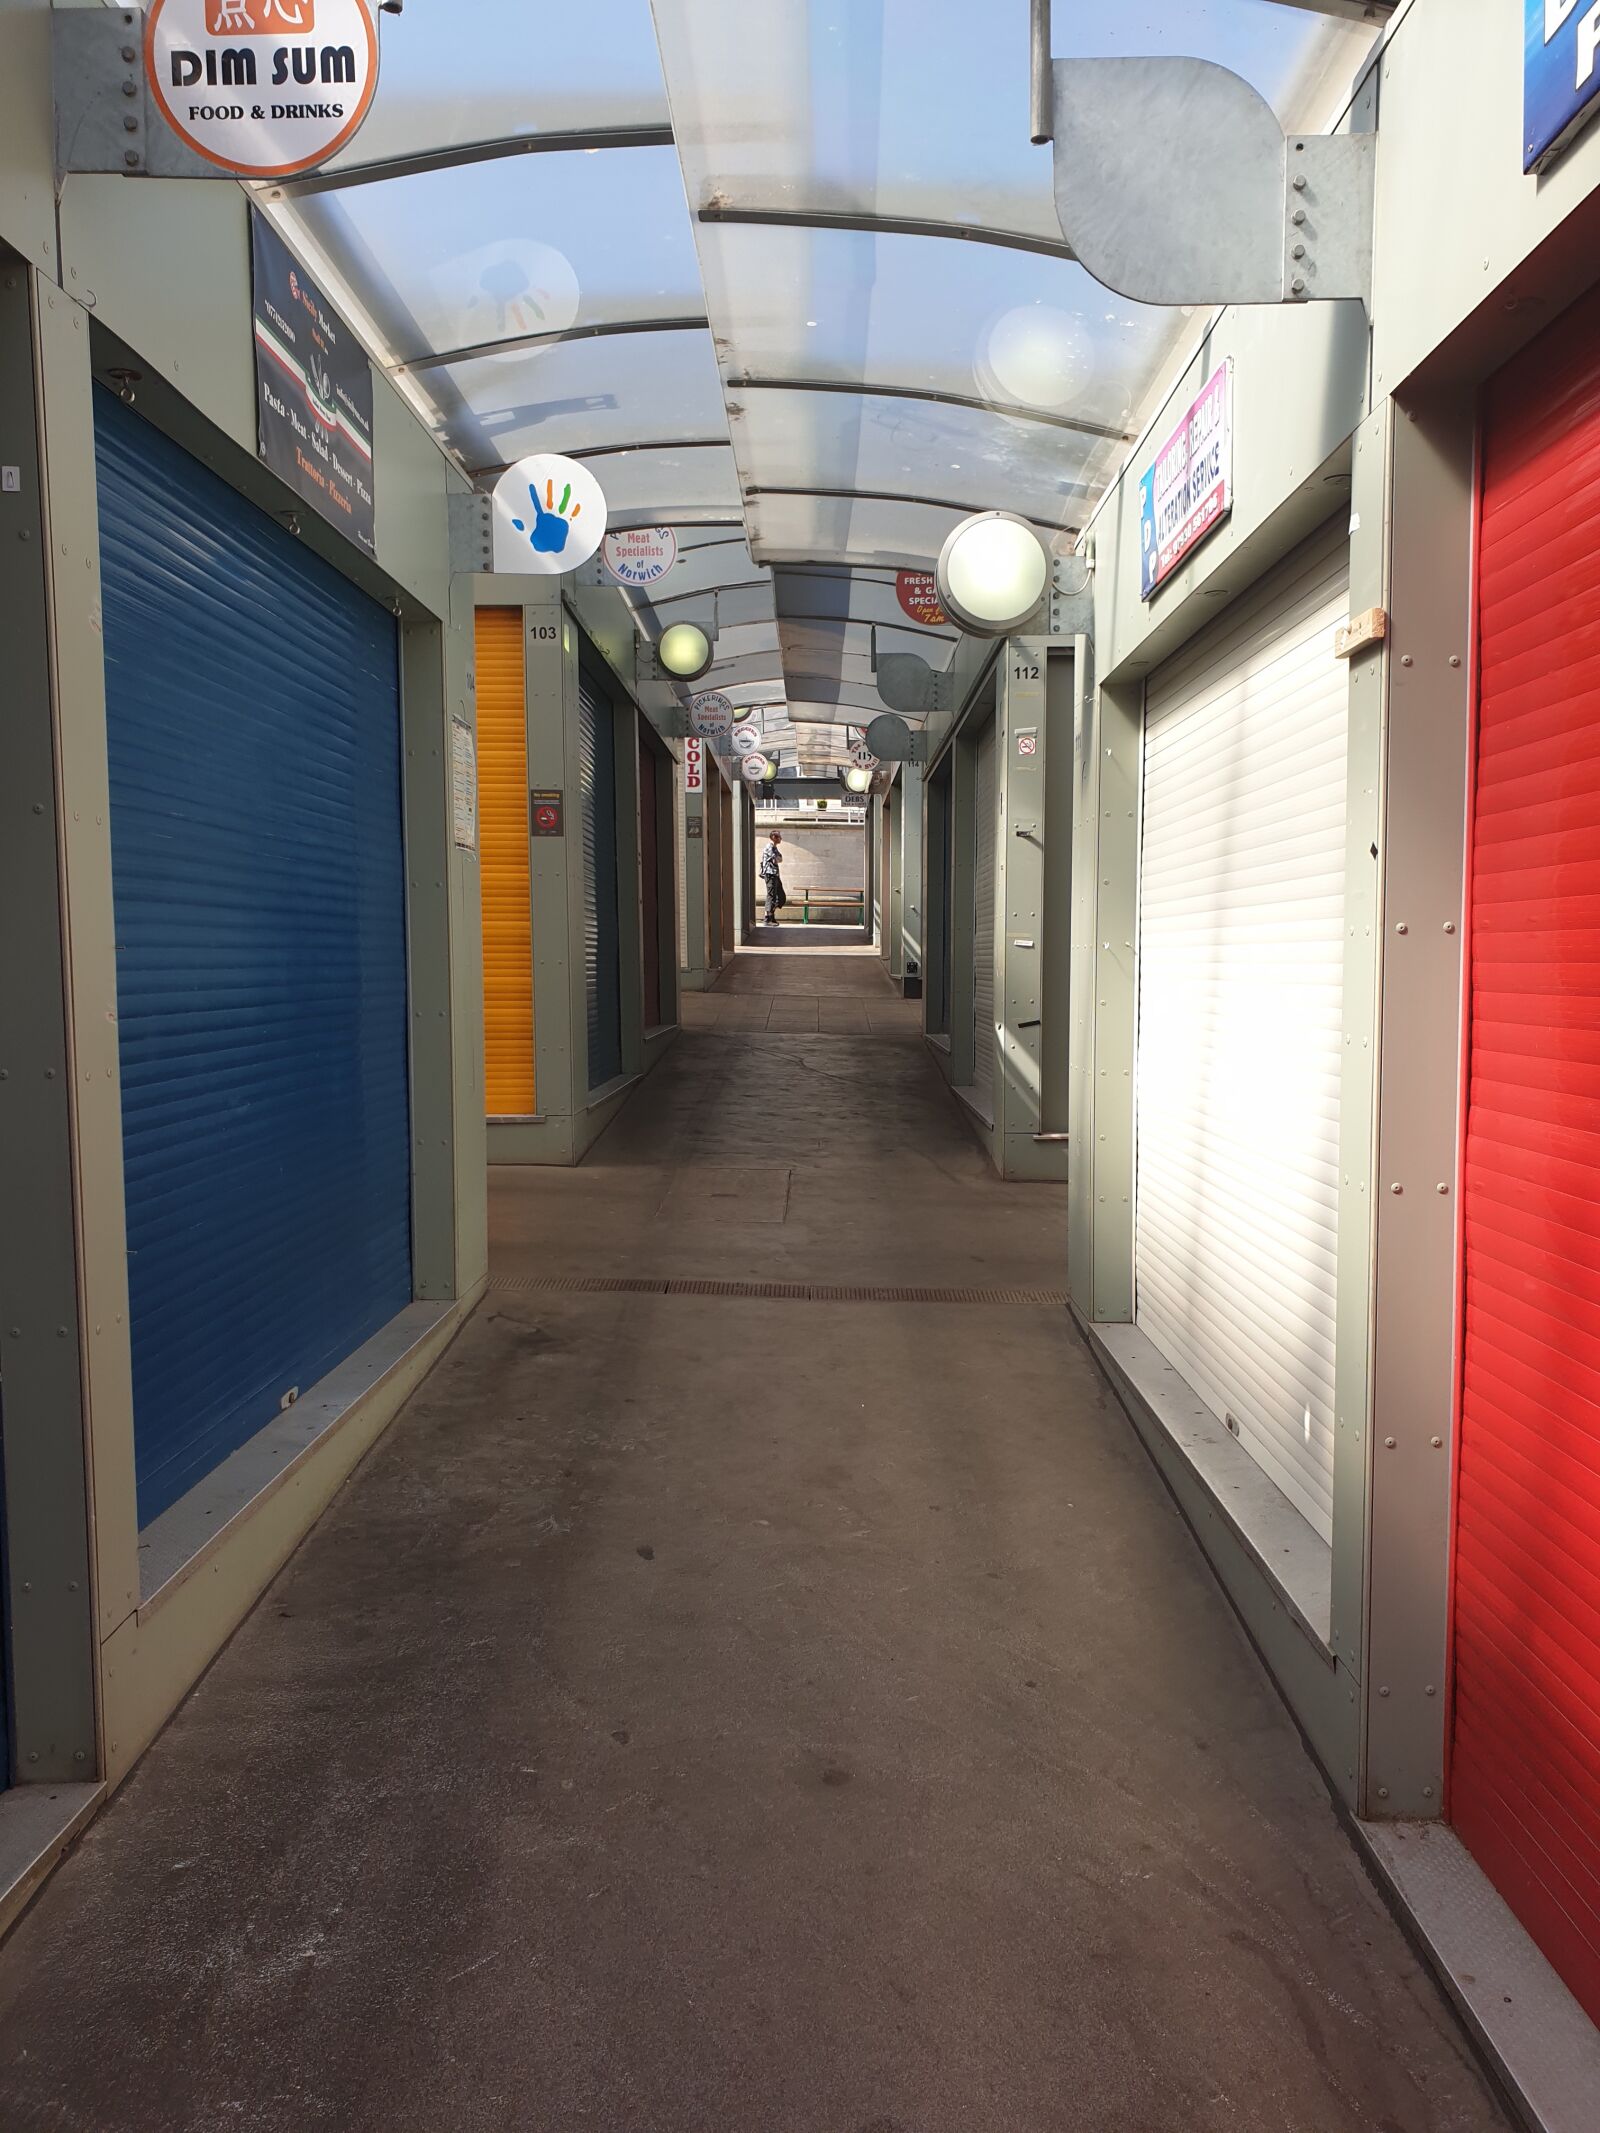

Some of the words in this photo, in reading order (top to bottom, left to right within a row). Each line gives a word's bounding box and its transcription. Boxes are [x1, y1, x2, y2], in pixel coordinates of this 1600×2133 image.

[171, 48, 257, 87] DIM
[272, 46, 356, 86] SUM
[188, 105, 245, 121] FOOD
[250, 105, 266, 119] &
[271, 103, 344, 119] DRINKS
[318, 309, 337, 345] Market
[263, 381, 286, 418] Pasta
[290, 408, 308, 440] Meat
[311, 431, 329, 462] Salad
[332, 452, 354, 488] Dessert
[356, 478, 372, 506] Pizza
[296, 446, 325, 488] Trattoria
[328, 479, 353, 514] Pizzeria
[1158, 476, 1192, 543] ALTERATION
[1192, 440, 1220, 502] SERVICE
[627, 532, 650, 543] Meat
[615, 546, 664, 557] Specialists
[1160, 547, 1173, 568] Tel:
[617, 562, 663, 580] Norwich
[636, 560, 644, 568] of
[904, 576, 933, 584] FRESH
[914, 586, 921, 595] &
[530, 626, 557, 640] 103
[1014, 666, 1040, 680] 112
[694, 694, 730, 710] PICKERINGS
[697, 713, 727, 721] Specialists
[698, 723, 726, 735] Norwich
[686, 737, 701, 788] COLD
